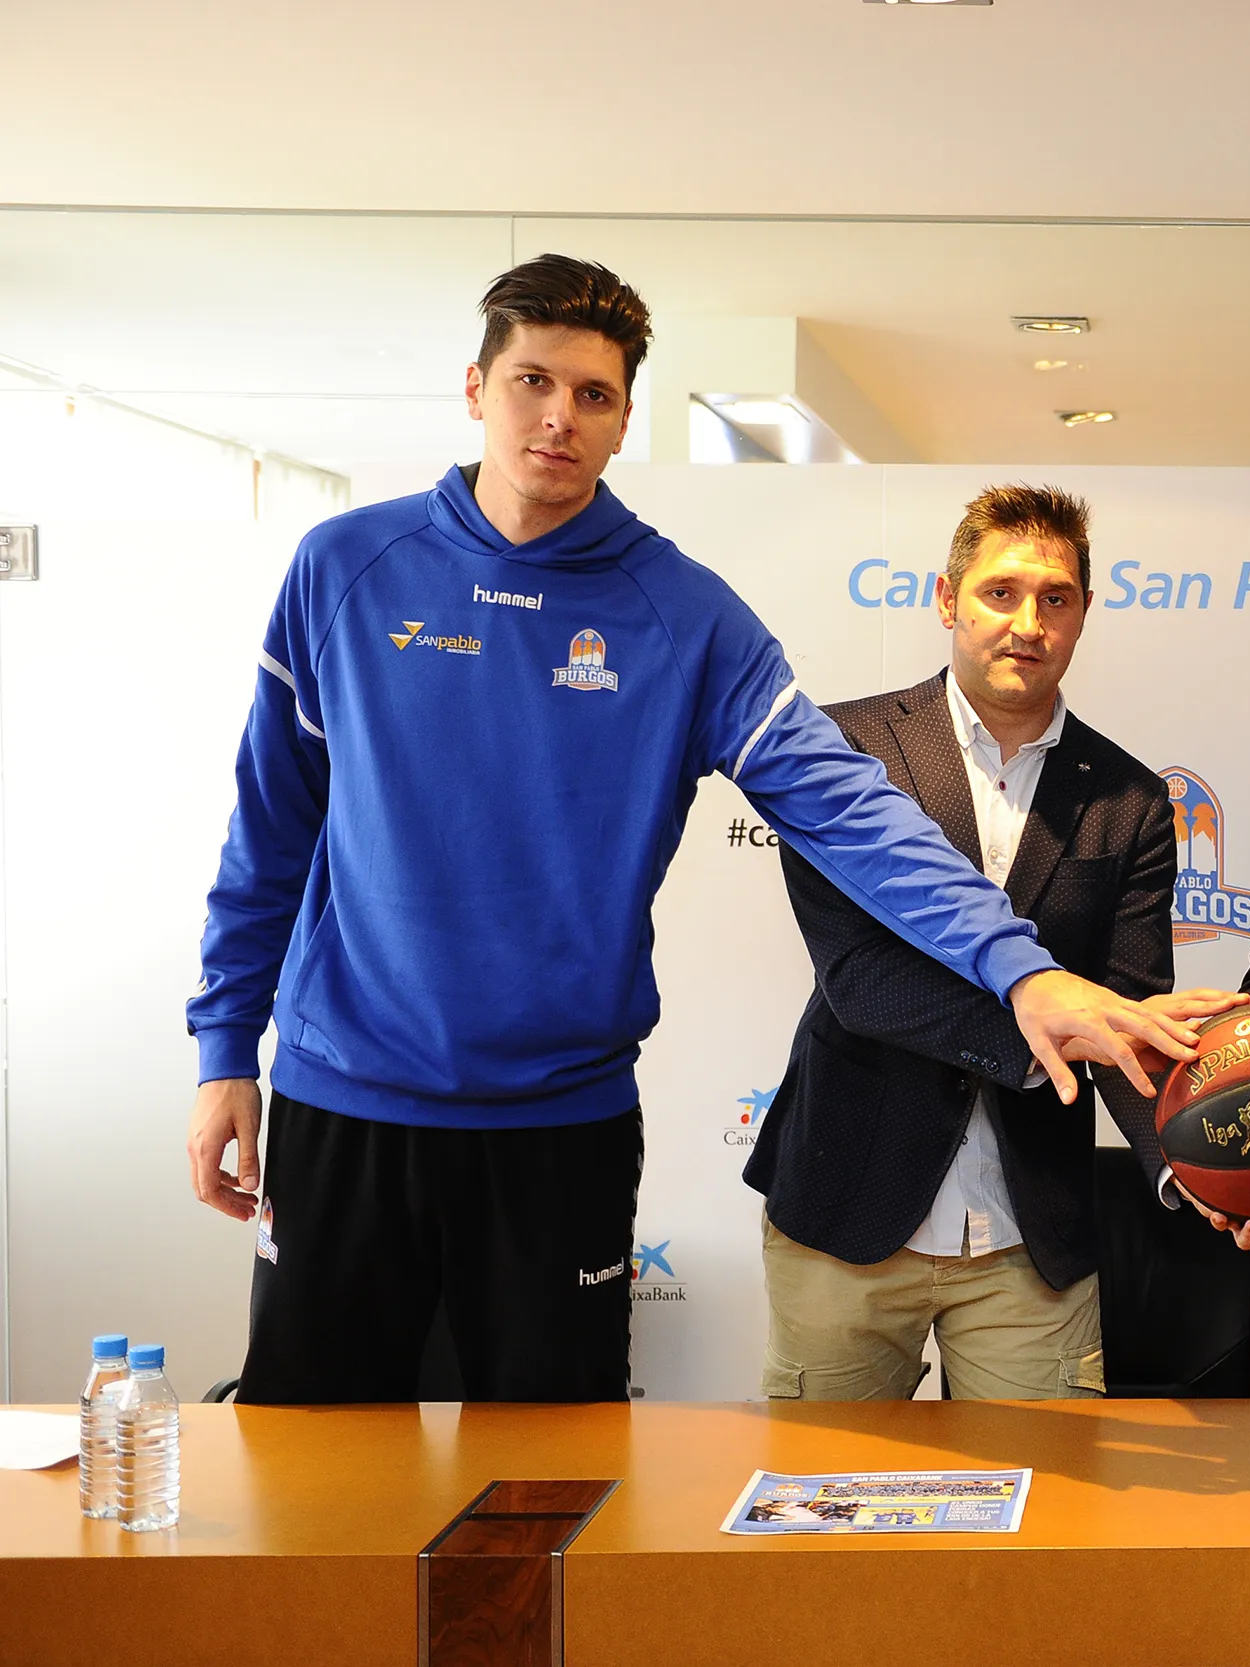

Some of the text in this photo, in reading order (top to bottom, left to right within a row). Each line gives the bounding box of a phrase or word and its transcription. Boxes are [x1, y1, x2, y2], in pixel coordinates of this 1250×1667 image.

[473, 583, 544, 611] hummel
[1103, 559, 1213, 610] San
[557, 670, 615, 687] BURGOS
[1202, 1116, 1243, 1147] liga
[579, 1256, 625, 1287] hummel
